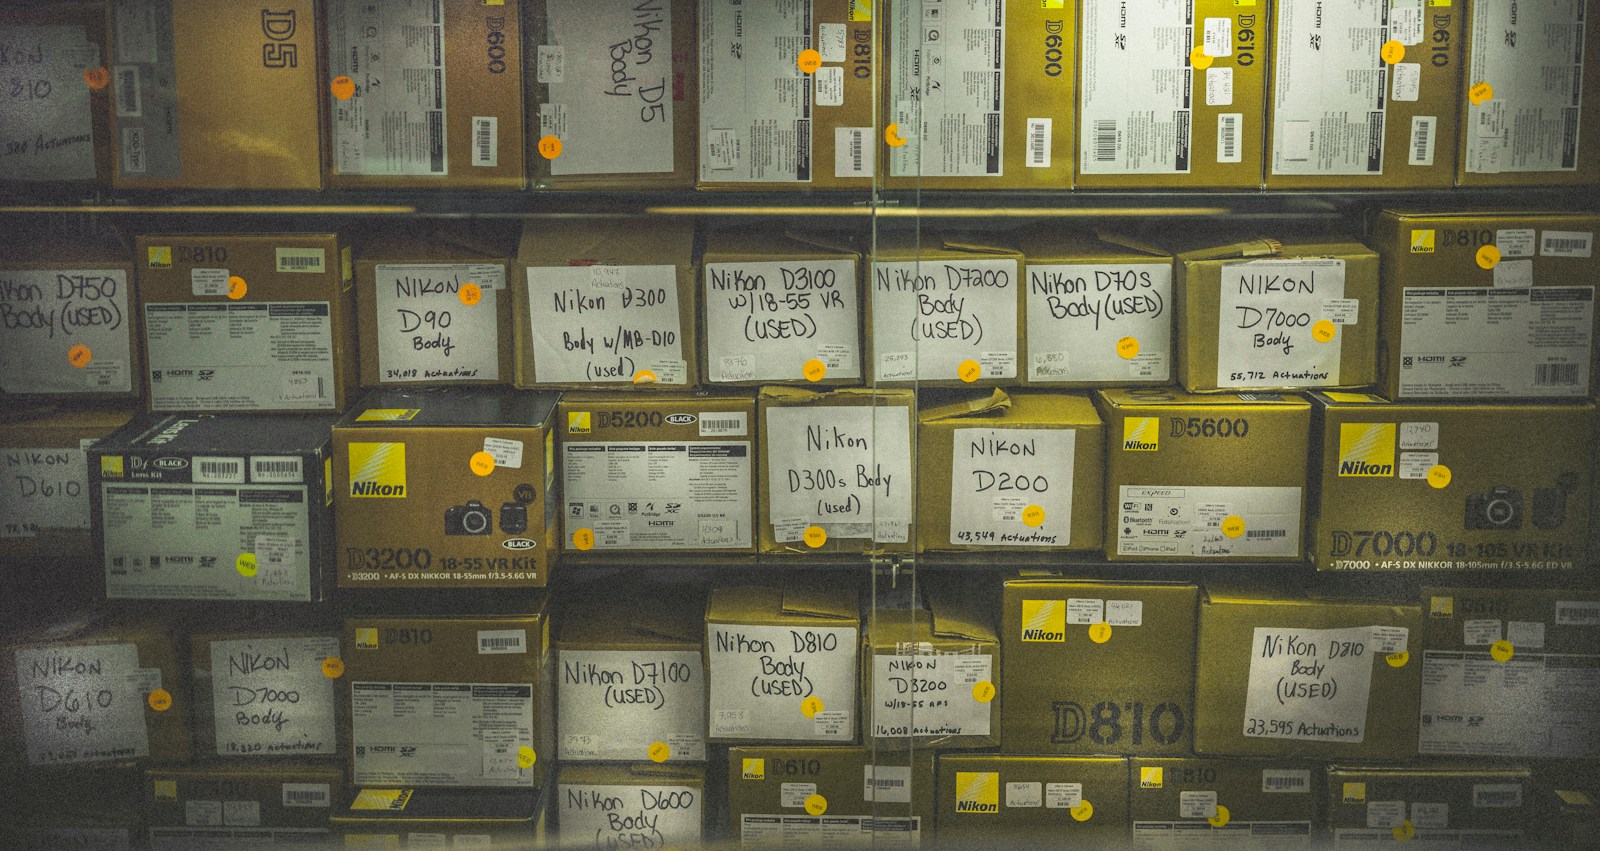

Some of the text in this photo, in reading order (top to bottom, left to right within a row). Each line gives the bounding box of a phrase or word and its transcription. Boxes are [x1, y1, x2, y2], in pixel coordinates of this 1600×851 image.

[735, 10, 743, 37] HDMI
[261, 9, 298, 69] D5
[486, 16, 508, 75] D600
[1044, 20, 1063, 77] D600
[1237, 14, 1255, 67] D610
[1432, 14, 1451, 68] D610
[853, 29, 871, 79] D810
[604, 38, 638, 97] Body
[638, 78, 665, 123] D5
[1442, 229, 1494, 247] D810
[178, 245, 229, 264] D810
[56, 274, 117, 299] D750
[395, 274, 460, 298] NIKON
[781, 267, 836, 291] D3100
[944, 264, 1010, 291] D7200
[1238, 270, 1316, 296] NIKON
[622, 286, 667, 308] D300
[820, 290, 845, 309] VR
[918, 293, 965, 325] Body
[1, 299, 122, 339] Body (USED)
[397, 309, 452, 334] D90
[1046, 289, 1165, 331] Body (USED)
[1235, 305, 1312, 331] D7000
[744, 312, 817, 343] (USED)
[911, 313, 984, 345] (USED)
[412, 331, 456, 357] Body
[562, 326, 595, 354] Body
[1253, 333, 1295, 355] Body
[166, 369, 194, 378] HDMI
[424, 366, 479, 378] Actuations
[587, 356, 636, 380] (used)
[1230, 365, 1330, 382] 55,712 Actuations
[569, 426, 590, 434] Nikon
[598, 411, 662, 429] D5200
[669, 415, 694, 424] BLACK
[1170, 417, 1250, 438] D5600
[970, 431, 1036, 459] NIKON
[1125, 440, 1157, 450] Nikon
[7, 451, 70, 467] NIKON
[158, 459, 184, 468] BLACK
[1340, 461, 1392, 475] Nikon
[16, 475, 82, 499] D610
[131, 471, 163, 479] Lens Kit
[788, 463, 892, 498] D300s Body
[972, 469, 1050, 493] D200
[352, 481, 405, 496] Nikon
[517, 489, 534, 499] VR
[817, 493, 862, 516] (used)
[508, 540, 532, 548] BLACK
[958, 525, 1057, 543] 43,549 Actuations
[1331, 531, 1438, 557] D7000
[239, 559, 256, 570] WEB
[346, 547, 537, 571] D3200 18-55 VR Kit
[1336, 561, 1371, 570] D7000
[1381, 561, 1402, 570] AF-S
[1403, 561, 1418, 570] DX
[1419, 561, 1453, 570] NIKKOR
[1455, 561, 1500, 570] 18-105mm
[353, 572, 538, 581] D3200 AF-S DX NIKKOR 18-55mm f/3.5-5.6G VR
[384, 628, 433, 646] D810
[790, 630, 838, 654] D810
[1024, 630, 1063, 642] Nikon
[228, 644, 290, 677] NIKON
[1328, 640, 1365, 660] D810
[1387, 653, 1404, 662] WEB
[32, 656, 102, 678] NIKON
[631, 659, 692, 686] D7100
[760, 655, 807, 684] Body
[888, 658, 937, 672] NIKON
[1291, 660, 1326, 681] Body
[227, 687, 300, 707] D7000
[751, 675, 815, 699] (USED)
[888, 677, 948, 694] D3200
[1276, 677, 1338, 705] (USED)
[35, 686, 113, 713] D610
[604, 685, 665, 711] (USED)
[236, 709, 289, 733] Body
[875, 724, 909, 737] 16,008
[1052, 700, 1185, 746] D810
[1247, 719, 1360, 738] 23,595 Actuations
[771, 758, 822, 777] D610
[1170, 766, 1217, 784] D810
[641, 788, 694, 811] D600
[958, 800, 997, 812] Nikon
[607, 811, 659, 835] Body
